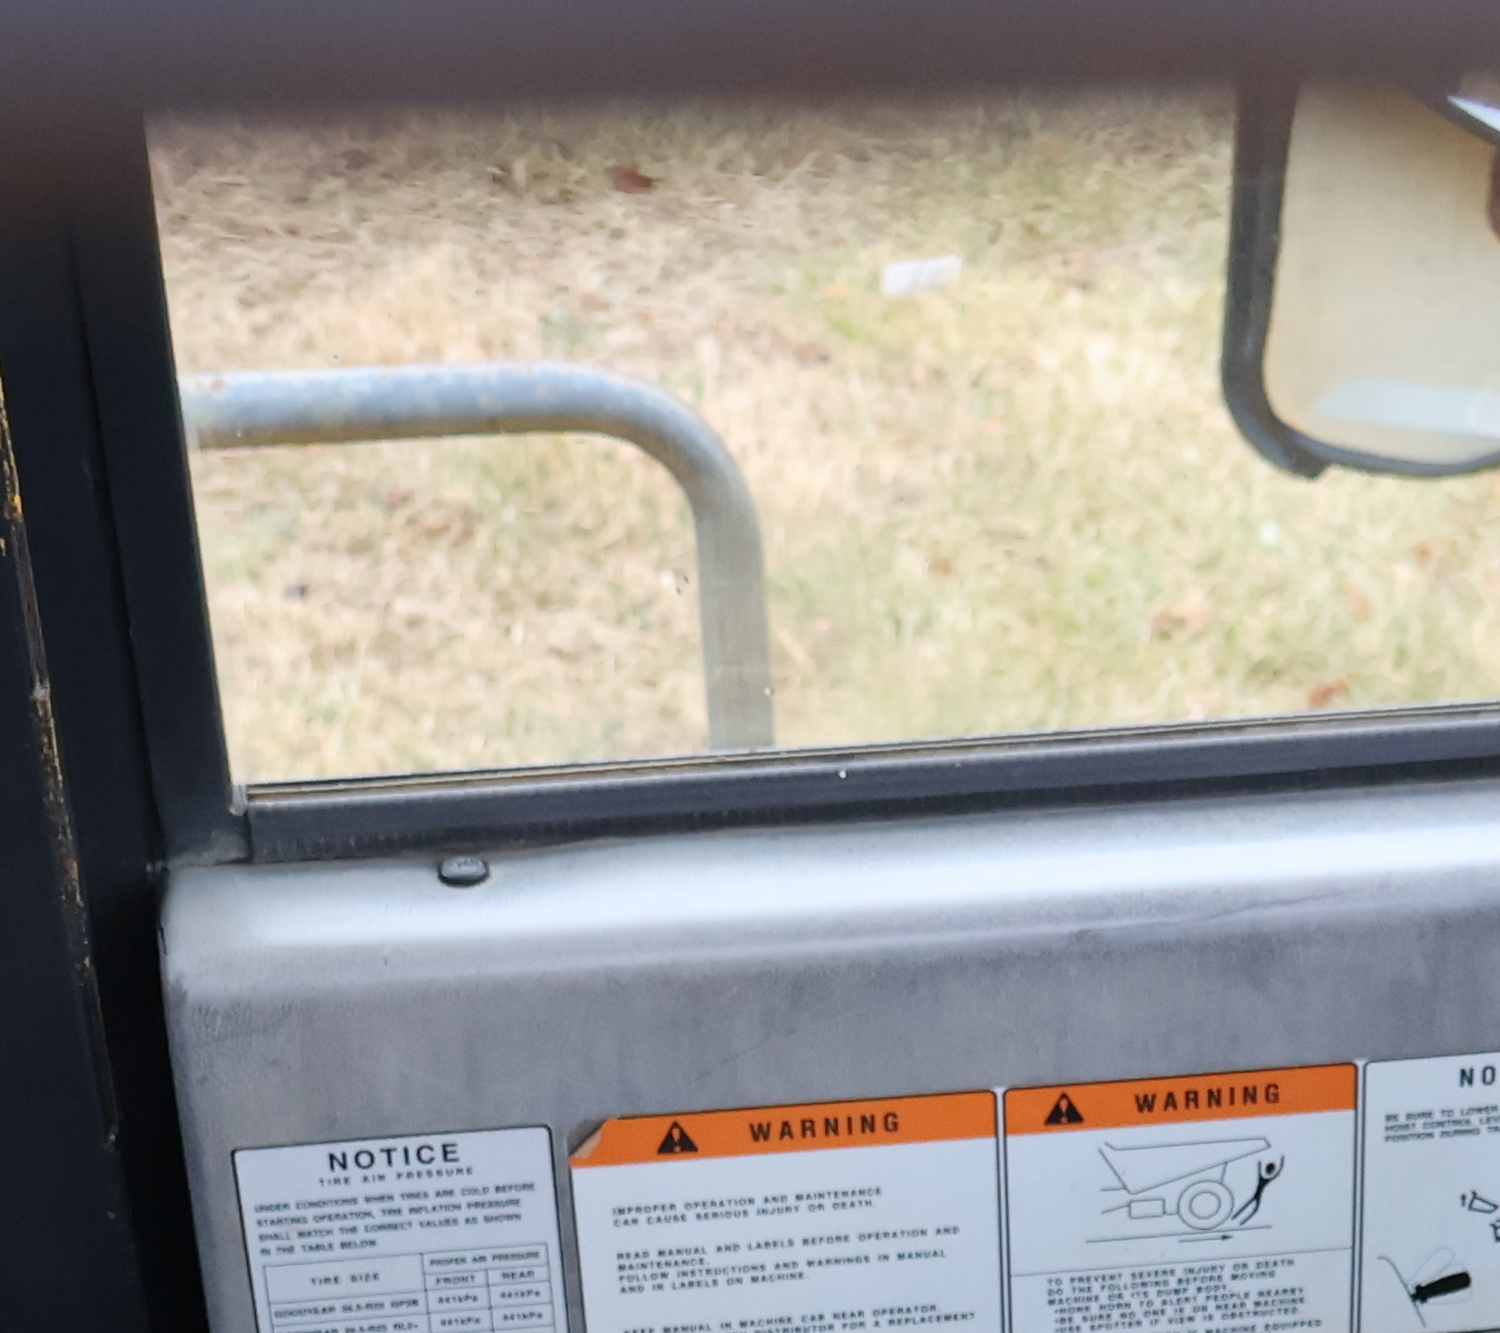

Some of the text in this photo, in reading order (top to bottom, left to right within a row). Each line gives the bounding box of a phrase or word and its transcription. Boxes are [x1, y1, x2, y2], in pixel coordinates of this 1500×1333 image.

[1133, 1081, 1280, 1115] WARNING
[748, 1110, 899, 1143] WARNING
[326, 1141, 460, 1172] NOTICE
